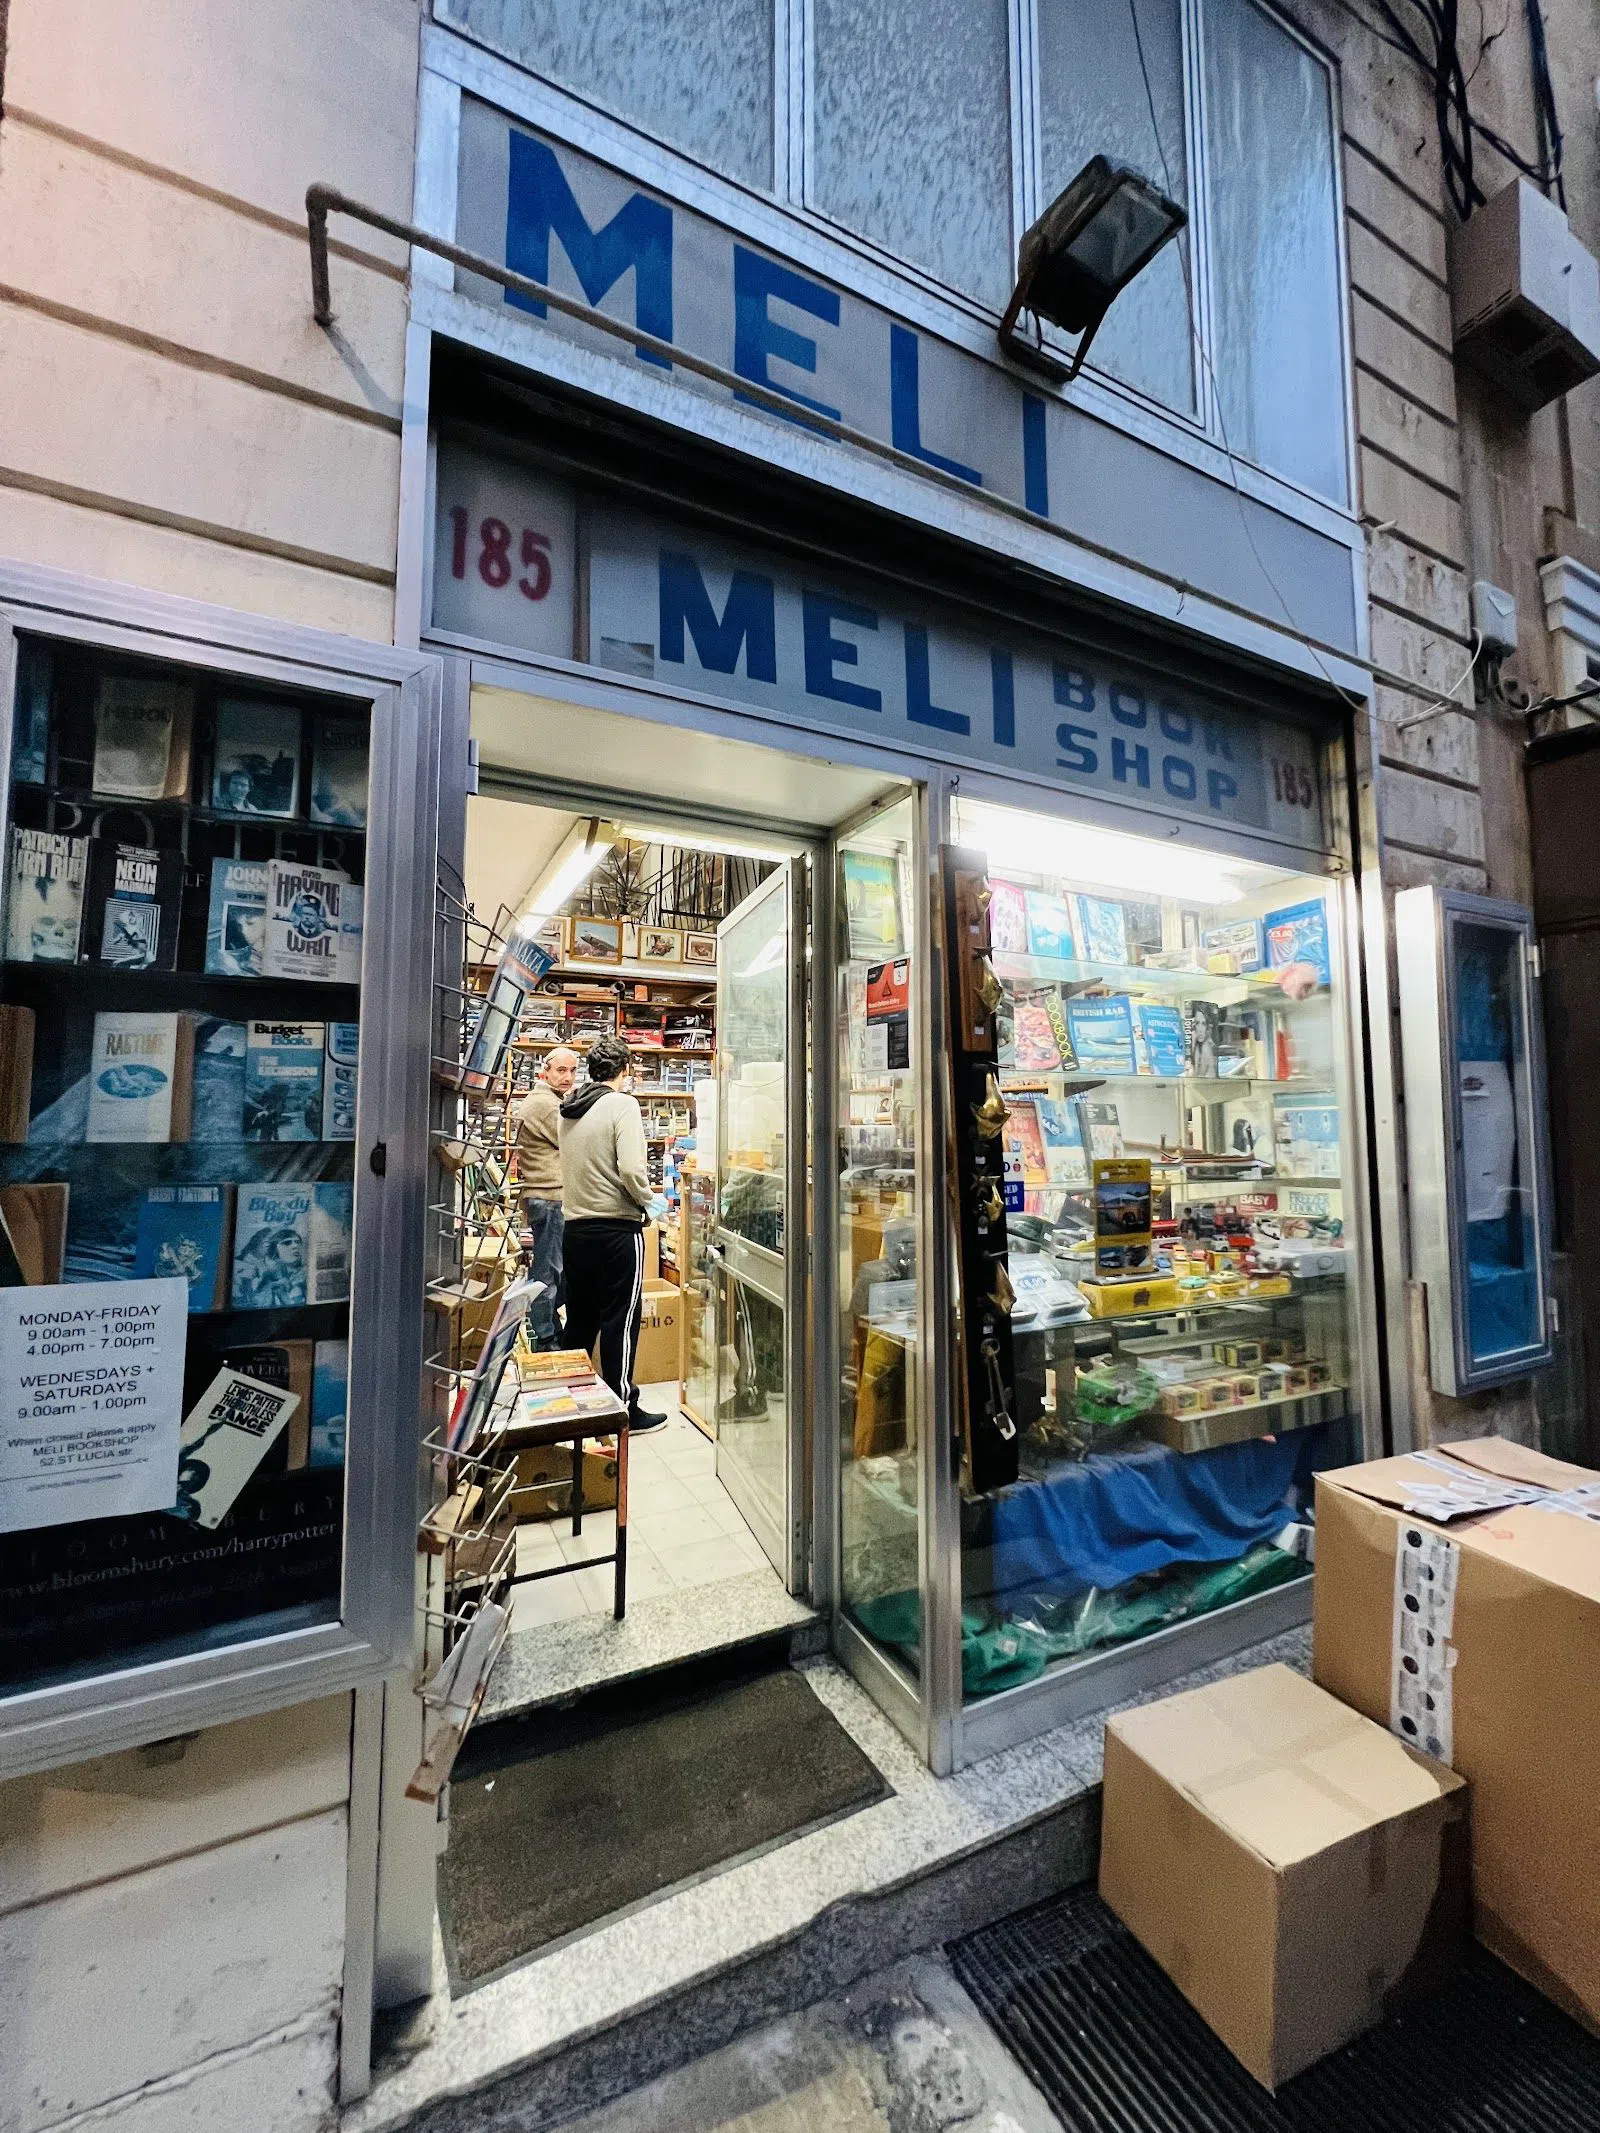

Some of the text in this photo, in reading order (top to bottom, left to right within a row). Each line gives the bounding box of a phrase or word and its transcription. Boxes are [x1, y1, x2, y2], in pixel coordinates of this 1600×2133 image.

[504, 128, 1049, 519] MELI
[450, 506, 552, 601] 185
[659, 546, 1016, 749] MELI
[1055, 722, 1238, 811] SHOP
[1271, 756, 1314, 810] 185
[115, 858, 158, 884] NEON
[254, 1022, 305, 1039] Budget
[1045, 993, 1073, 1060] COOKBOOK
[1183, 1017, 1193, 1045] Jordan
[271, 1034, 313, 1046] Books
[1240, 1194, 1269, 1206] BABY
[19, 1304, 162, 1326] MONDAY-FRIDAY
[28, 1327, 86, 1341] 9.00am
[102, 1321, 155, 1335] 1.00pm
[26, 1342, 85, 1356] 4.00pm
[100, 1336, 154, 1350] 7.00pm
[20, 1365, 141, 1388] WEDNESDAYS
[33, 1380, 137, 1402] SATURDAYS
[17, 1404, 76, 1419] 9.00am
[93, 1396, 146, 1411] 1.00pm
[210, 1403, 271, 1434] RANGE
[127, 1422, 157, 1435] apply
[67, 1435, 140, 1453] BOOKSHOP
